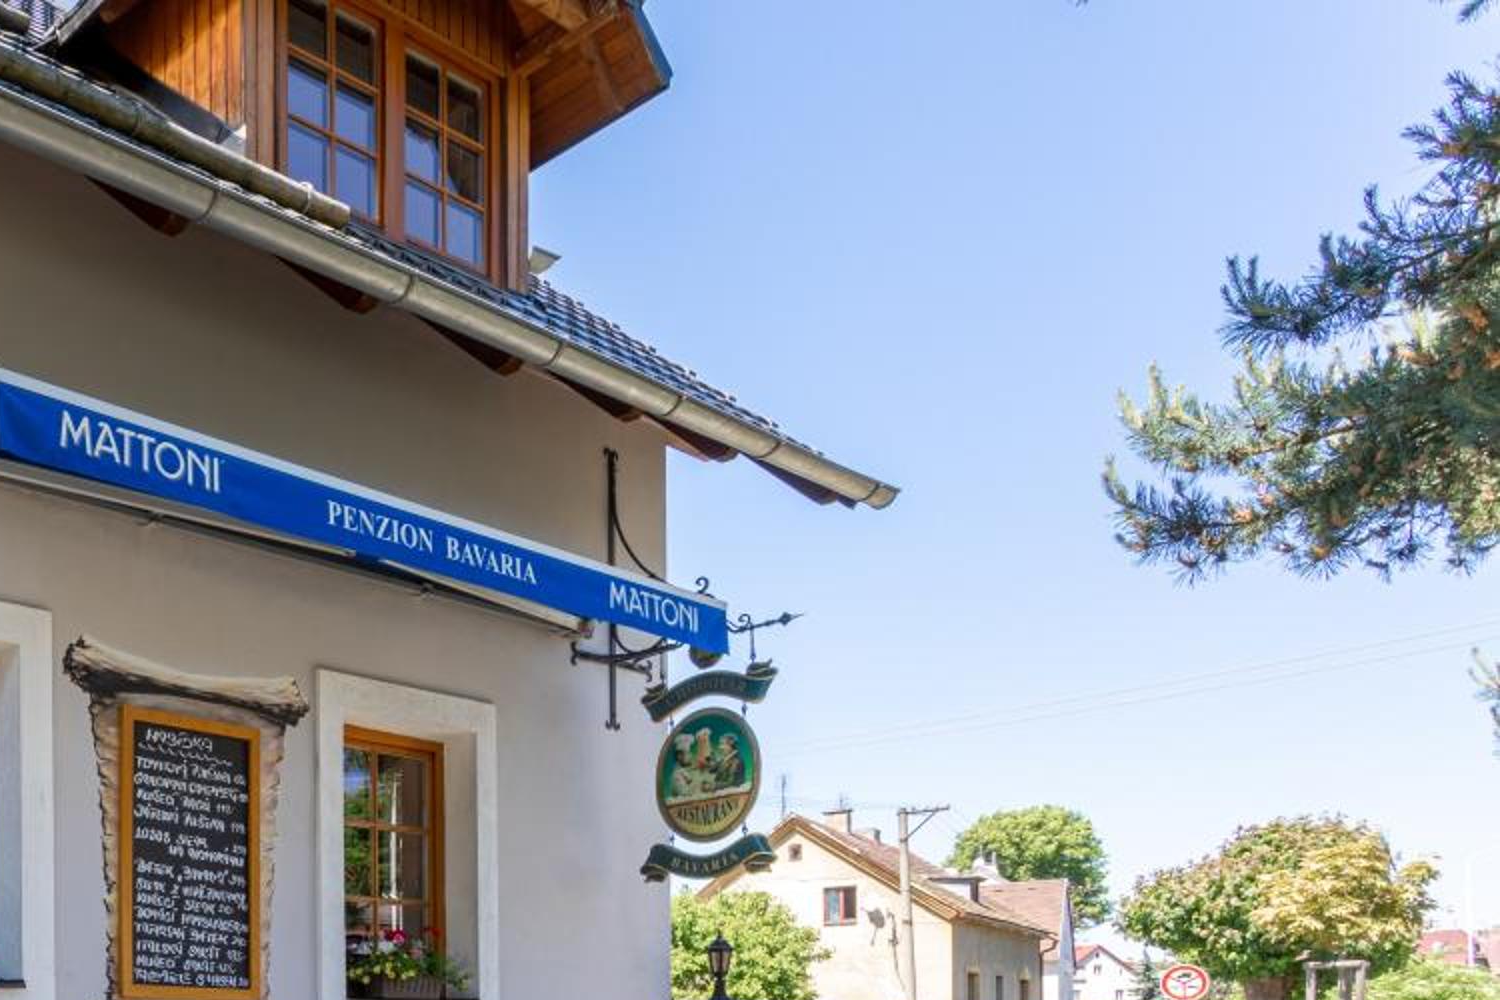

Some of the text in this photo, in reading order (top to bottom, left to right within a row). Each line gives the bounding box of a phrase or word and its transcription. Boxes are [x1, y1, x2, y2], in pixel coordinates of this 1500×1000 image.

[59, 409, 220, 494] MATTONI
[326, 499, 538, 585] PENZION BAVARIA
[609, 580, 699, 634] MATTONI
[671, 854, 740, 873] BAVARIA
